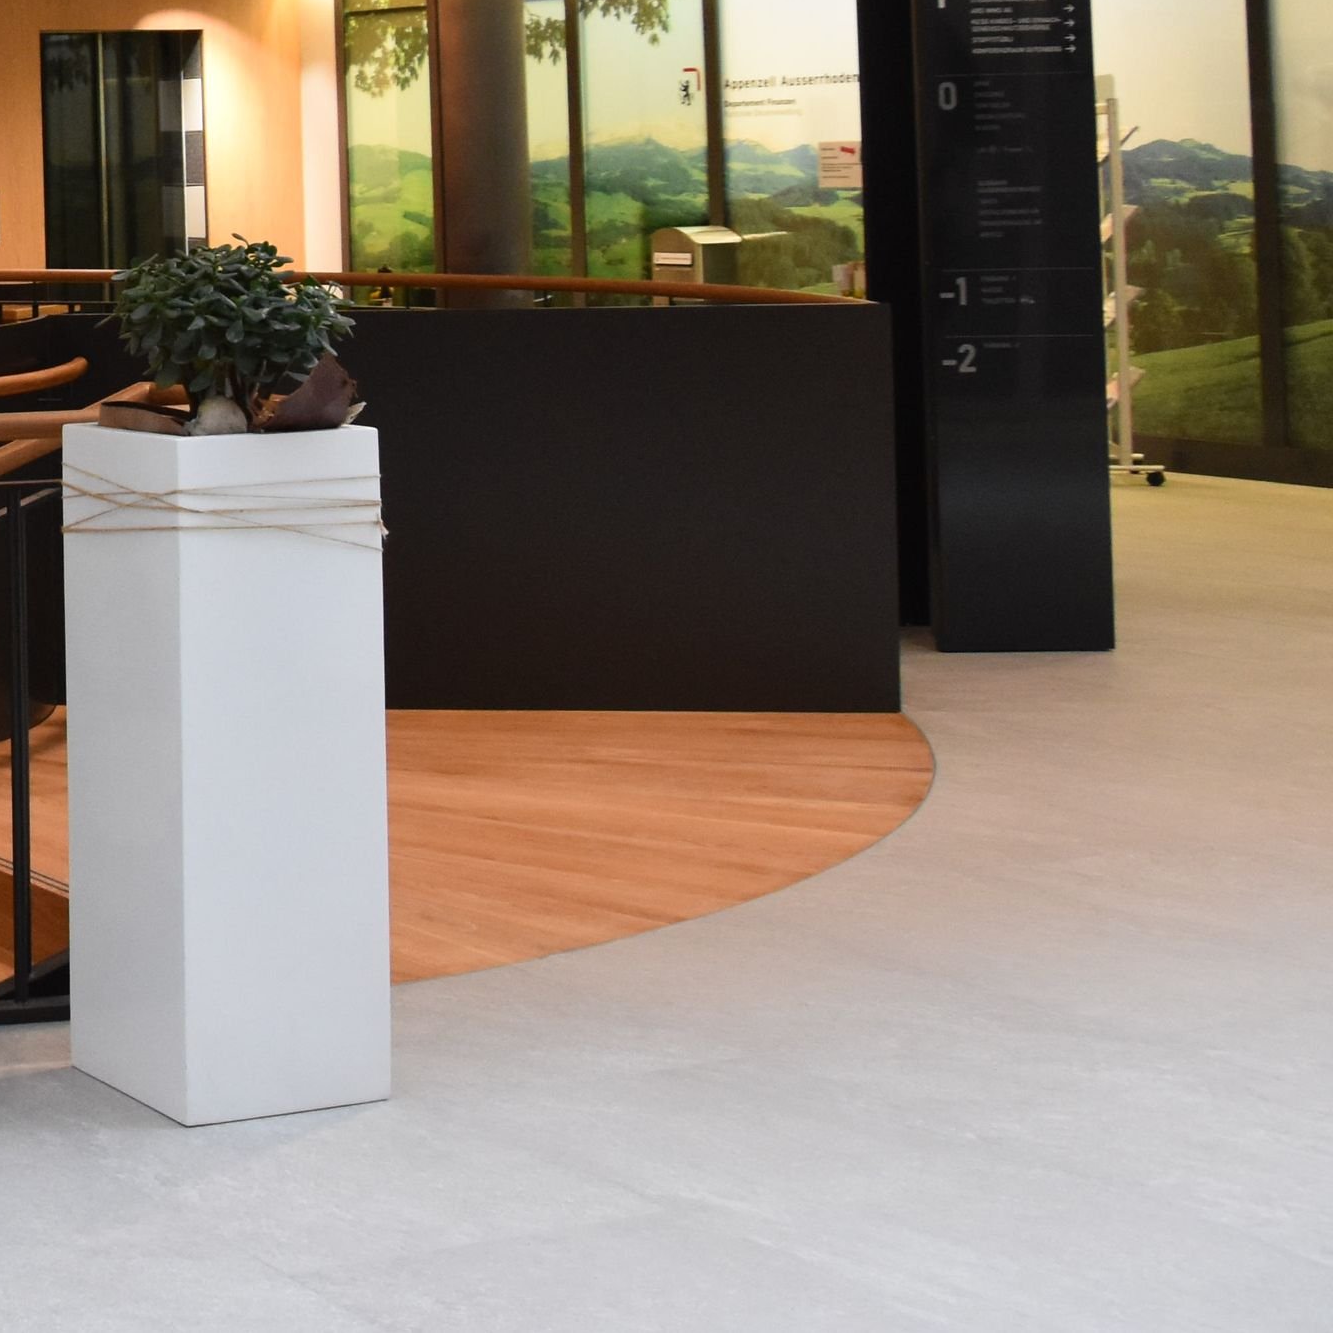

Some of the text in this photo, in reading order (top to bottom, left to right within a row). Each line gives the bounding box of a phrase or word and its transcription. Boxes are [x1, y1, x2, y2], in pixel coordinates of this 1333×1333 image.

[724, 73, 859, 89] Appenzell Ausserrhoden
[938, 81, 957, 110] 0
[939, 277, 967, 306] -1
[941, 343, 978, 373] -2
